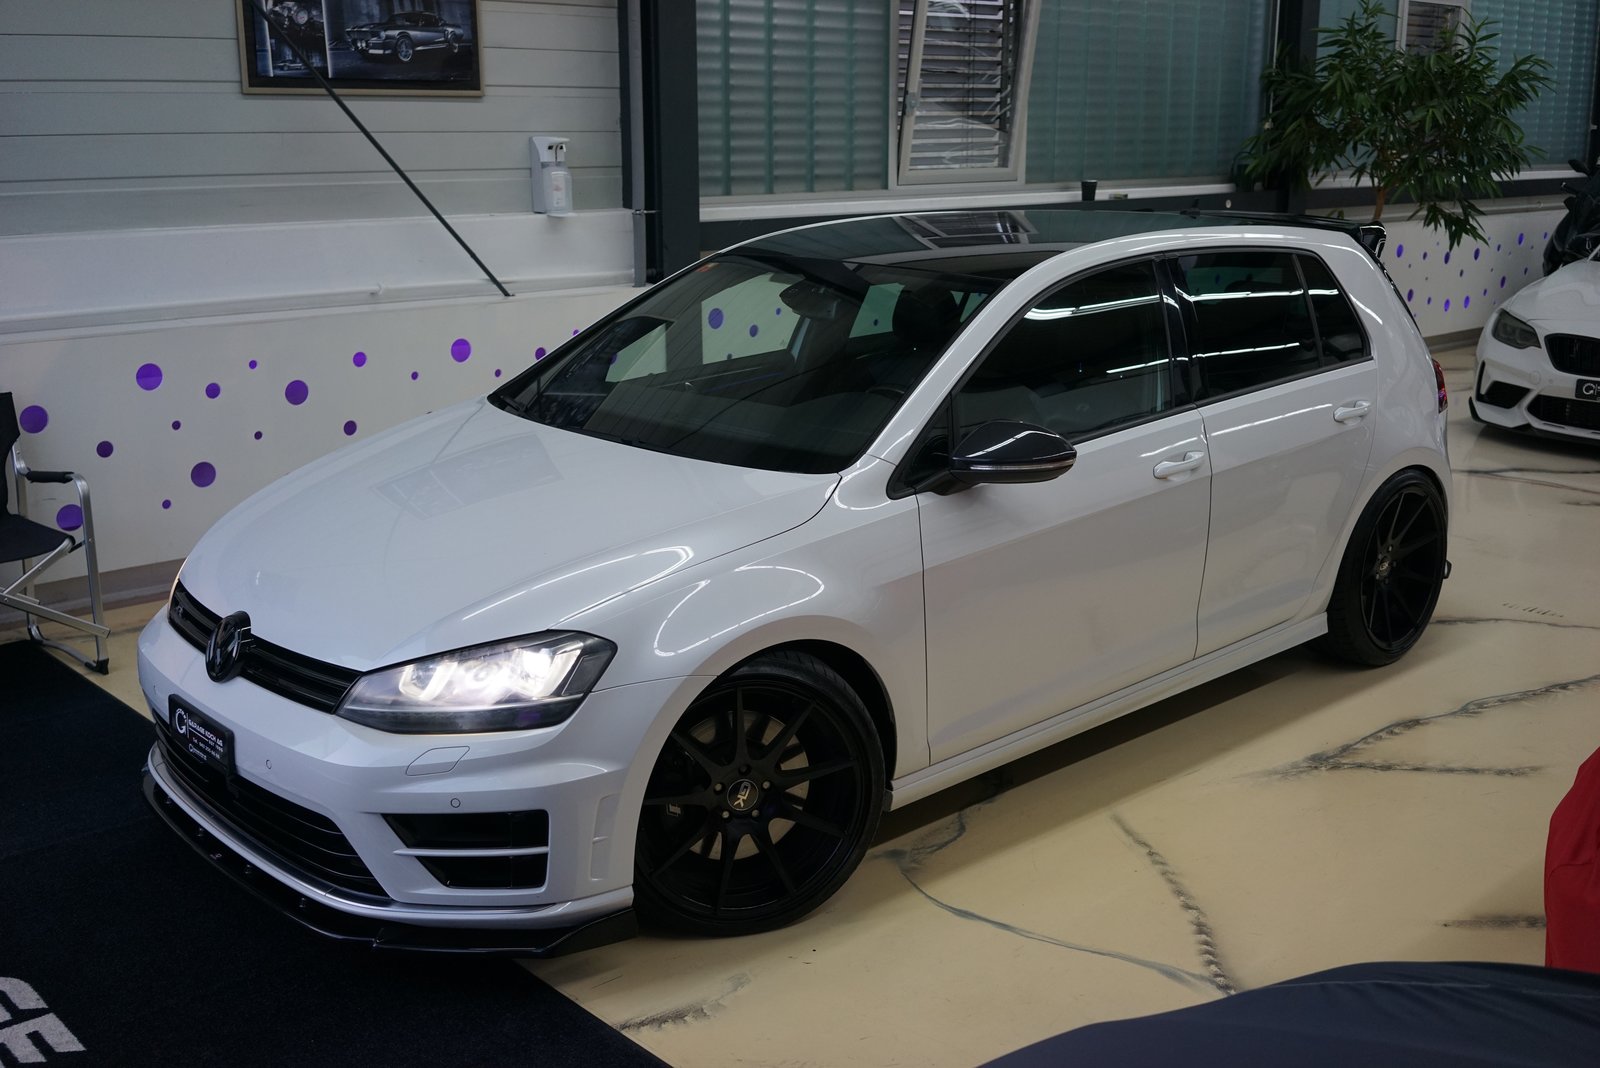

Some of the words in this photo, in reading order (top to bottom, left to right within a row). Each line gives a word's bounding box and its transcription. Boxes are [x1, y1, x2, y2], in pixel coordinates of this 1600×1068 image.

[188, 719, 205, 735] GARAGE
[205, 730, 216, 742] KOCH
[216, 738, 223, 747] AG
